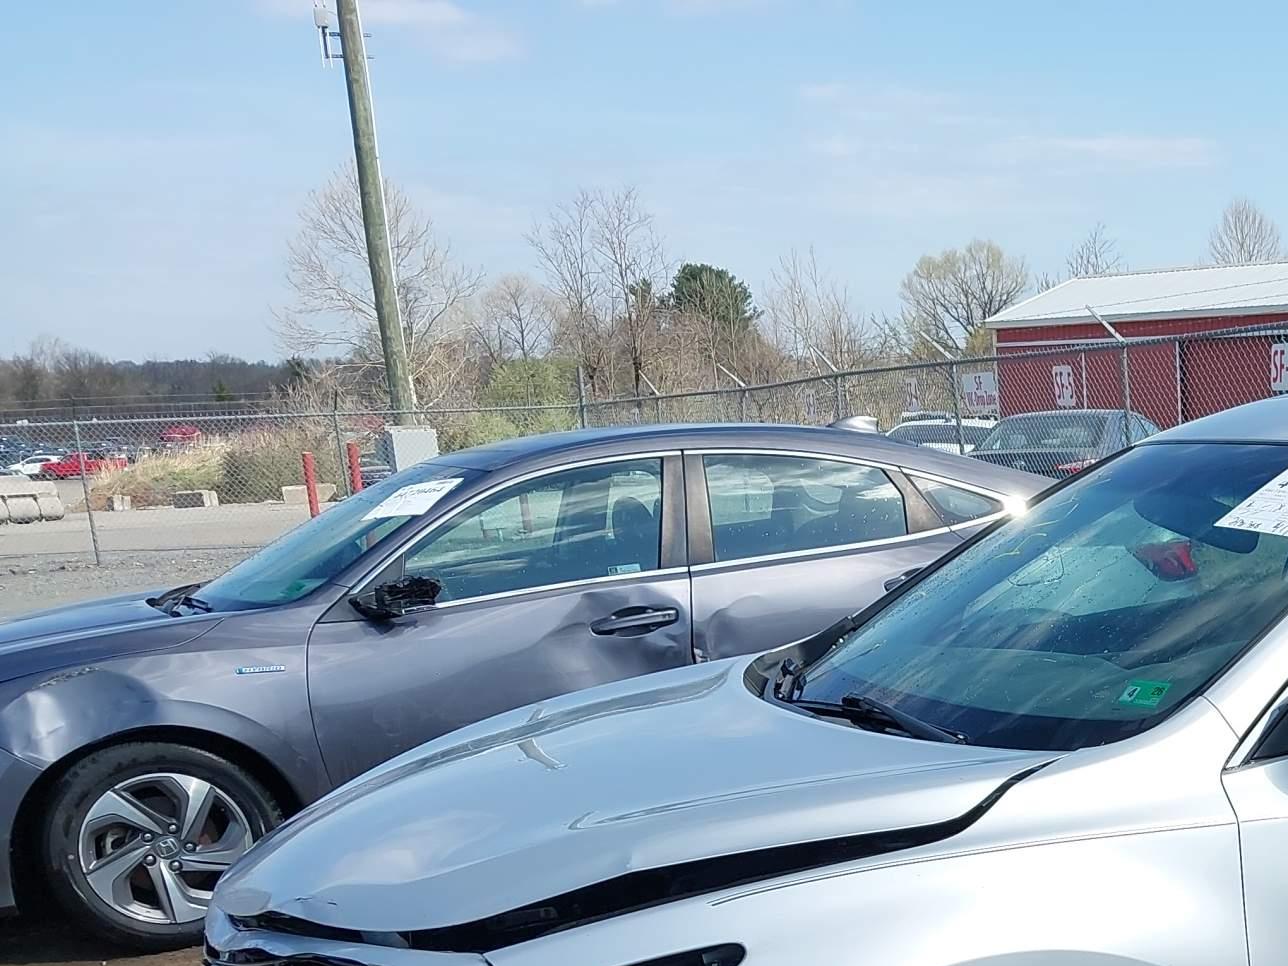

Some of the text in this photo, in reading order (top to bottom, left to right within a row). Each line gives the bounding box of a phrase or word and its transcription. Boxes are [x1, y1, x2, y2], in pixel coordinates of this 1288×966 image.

[974, 375, 983, 390] SF
[1055, 371, 1073, 399] SF-5
[1127, 687, 1138, 698] 4
